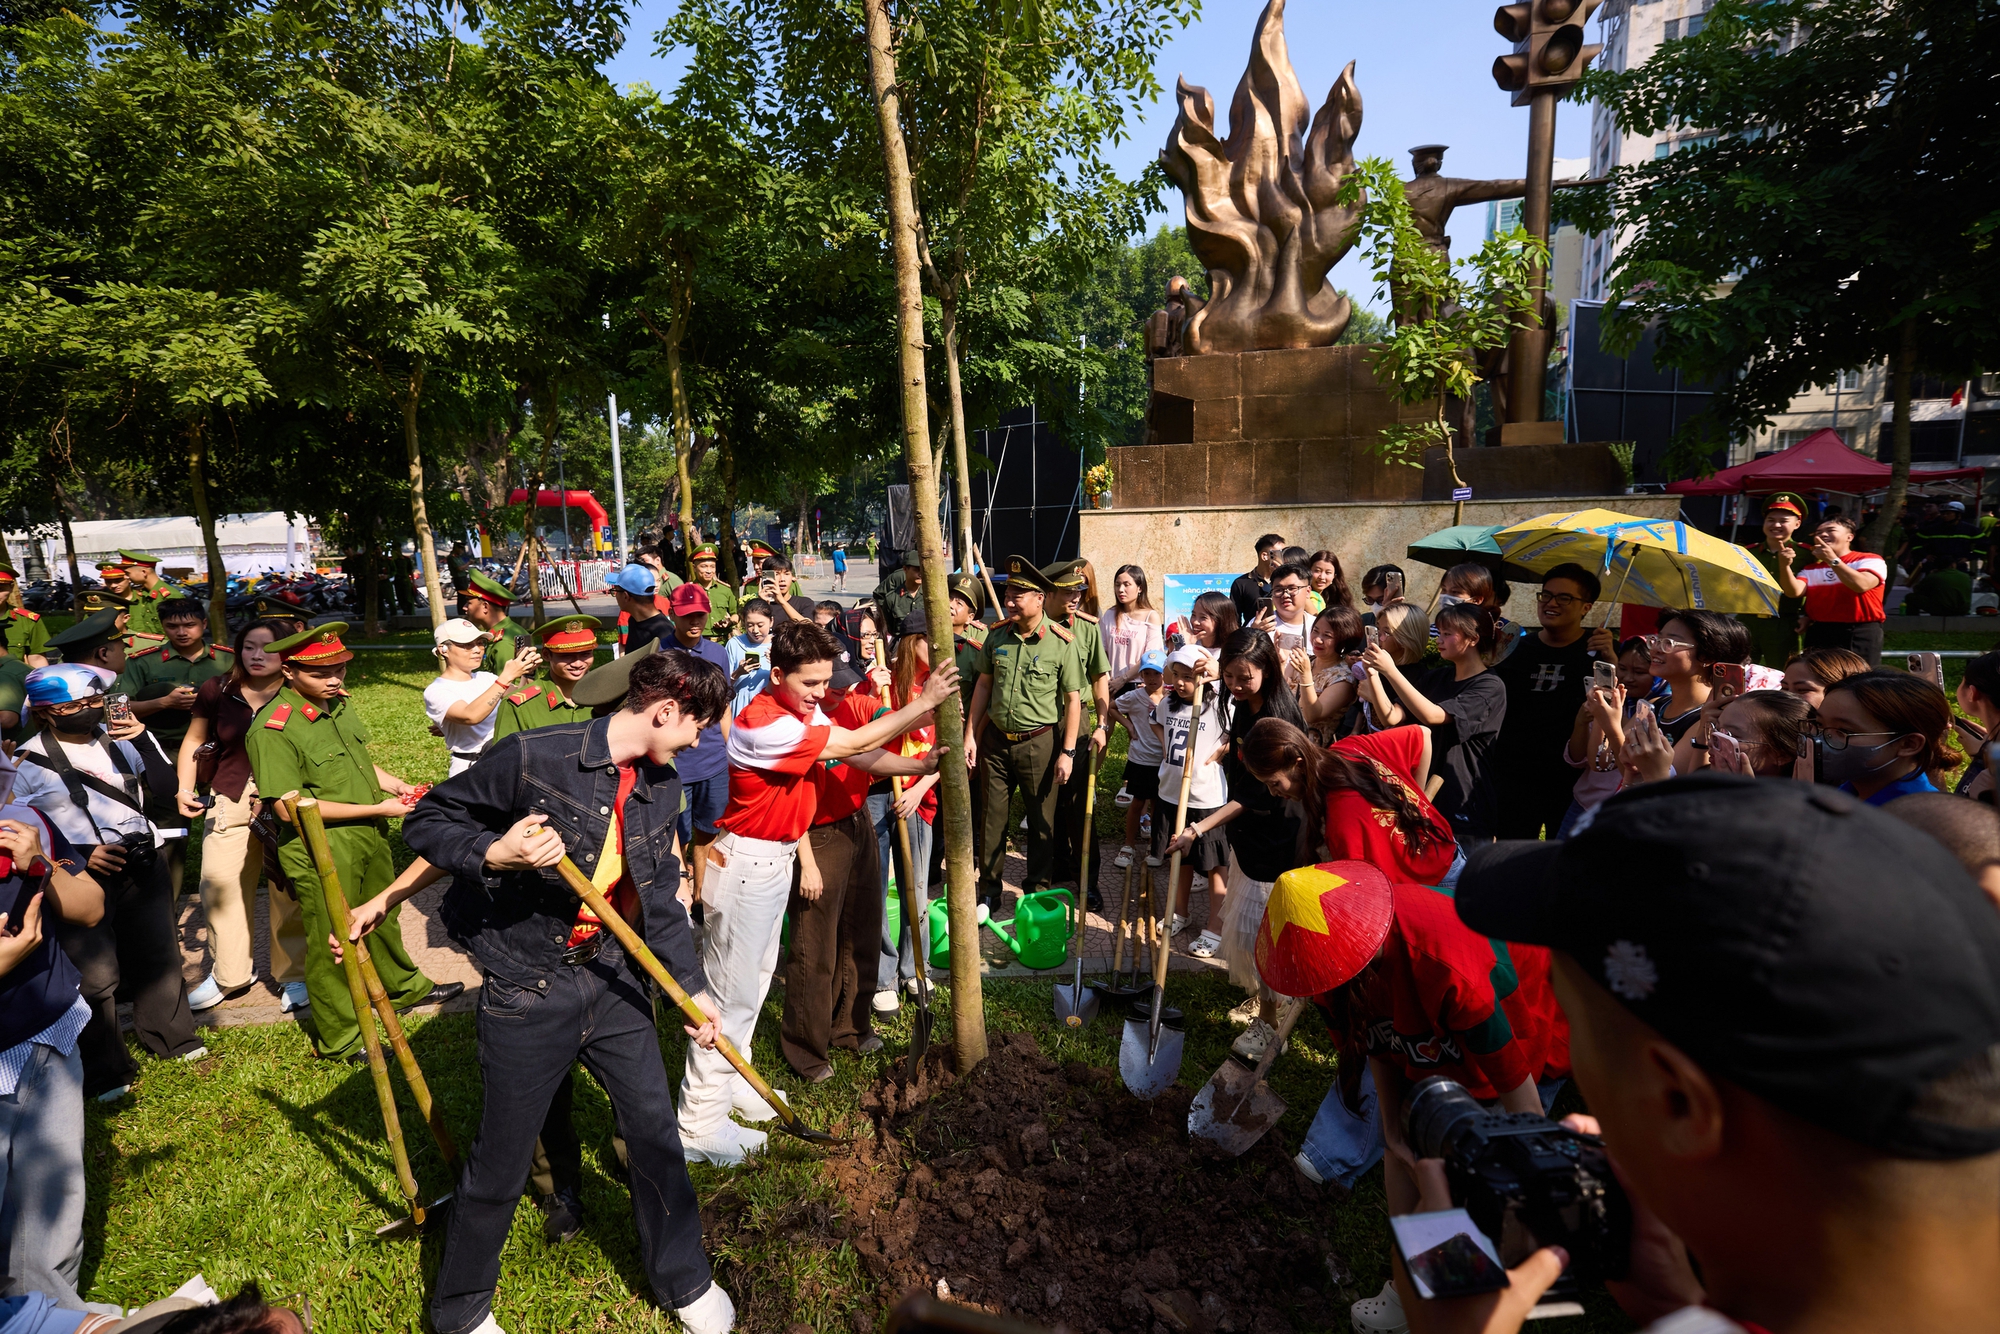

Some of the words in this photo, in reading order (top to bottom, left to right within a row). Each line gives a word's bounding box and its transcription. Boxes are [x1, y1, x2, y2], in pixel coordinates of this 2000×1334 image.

[604, 528, 611, 539] P
[1177, 717, 1206, 731] KICR
[1165, 728, 1189, 767] 12
